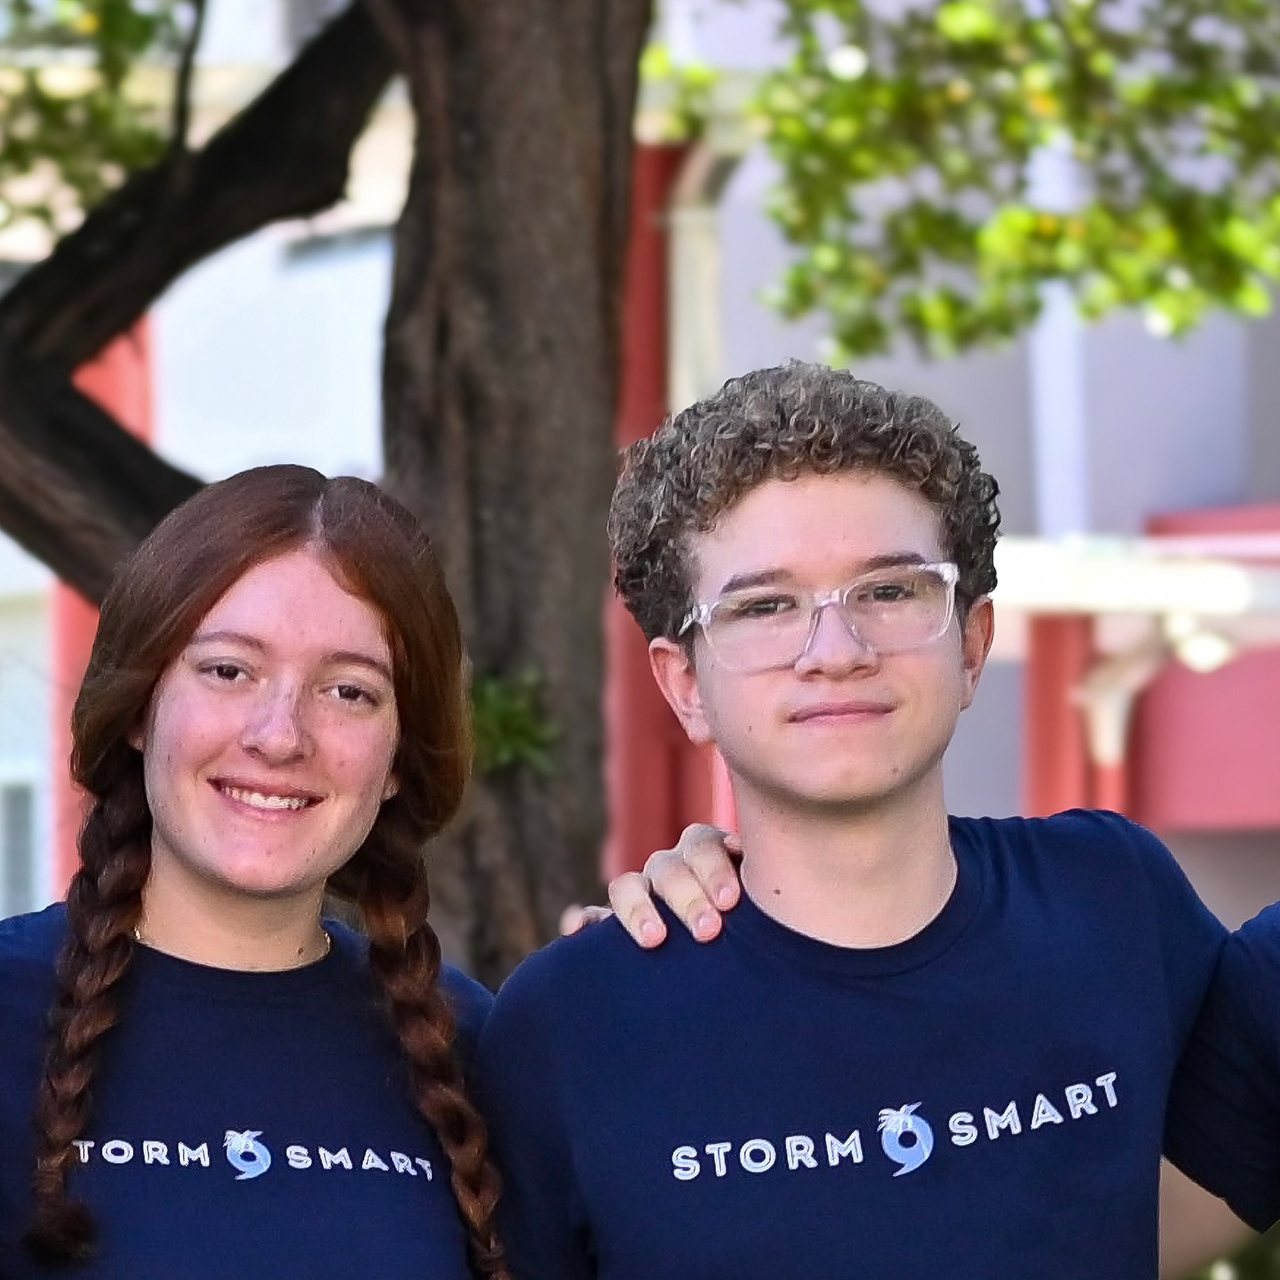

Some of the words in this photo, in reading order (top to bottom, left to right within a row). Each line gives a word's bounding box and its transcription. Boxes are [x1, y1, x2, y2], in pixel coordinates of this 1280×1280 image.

[71, 1139, 211, 1168] TORM
[284, 1144, 434, 1182] SMART
[671, 1129, 864, 1181] STORM
[947, 1071, 1119, 1147] SMART
